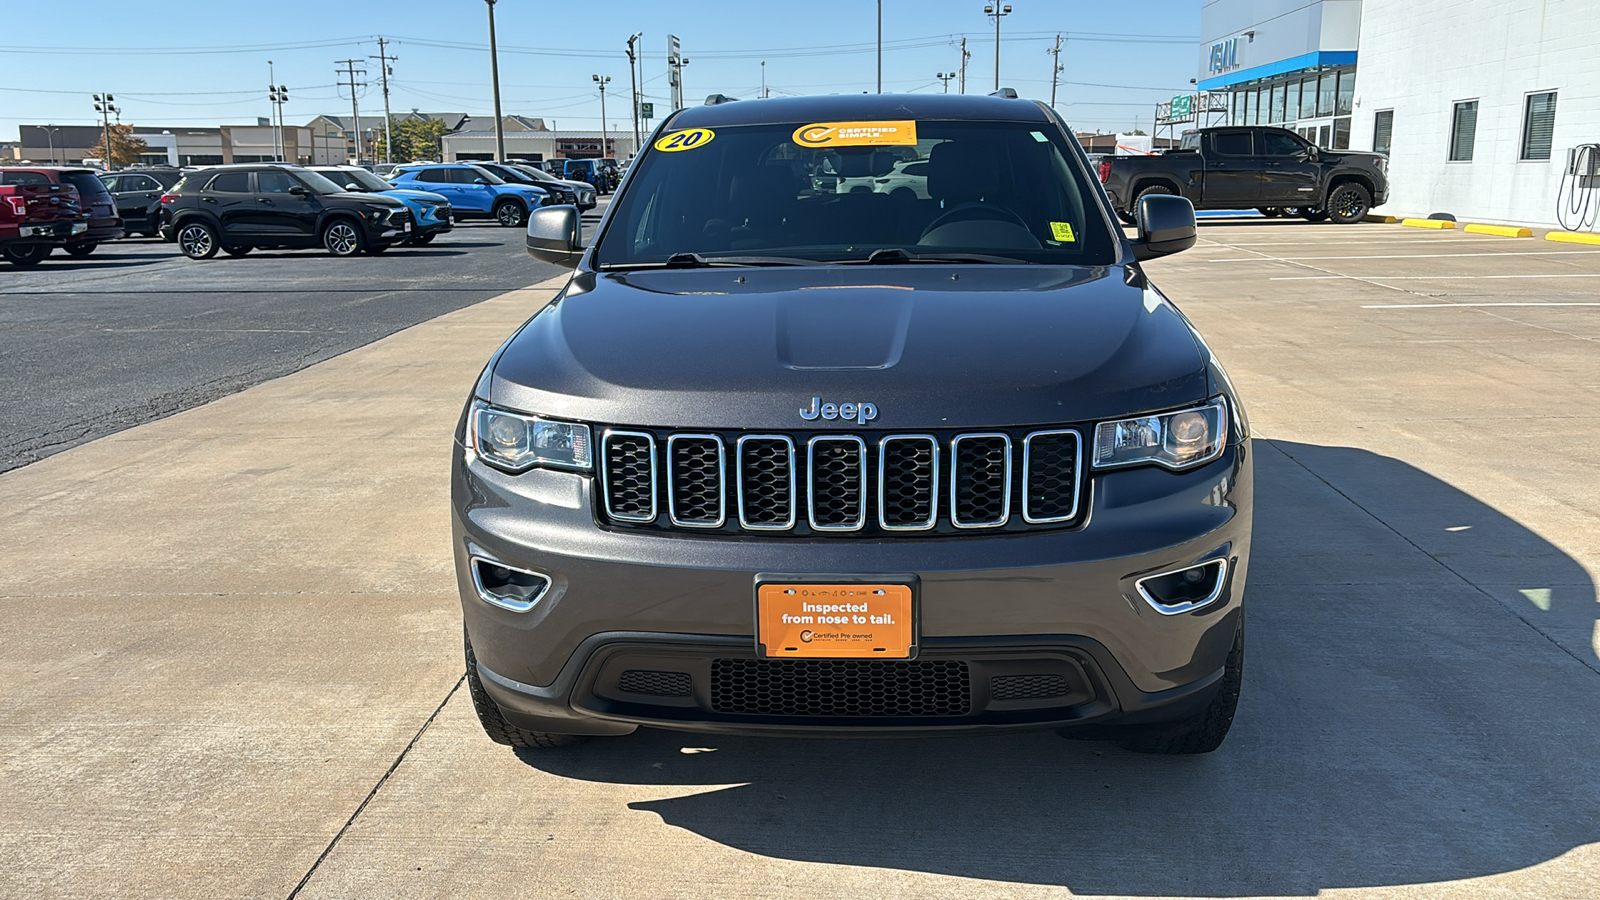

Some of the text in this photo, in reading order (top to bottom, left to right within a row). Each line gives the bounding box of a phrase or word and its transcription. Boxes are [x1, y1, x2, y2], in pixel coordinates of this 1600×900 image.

[665, 132, 703, 149] 20
[799, 397, 877, 424] Jeep
[802, 602, 868, 614] Inspected
[782, 613, 895, 624] from nose to tail.
